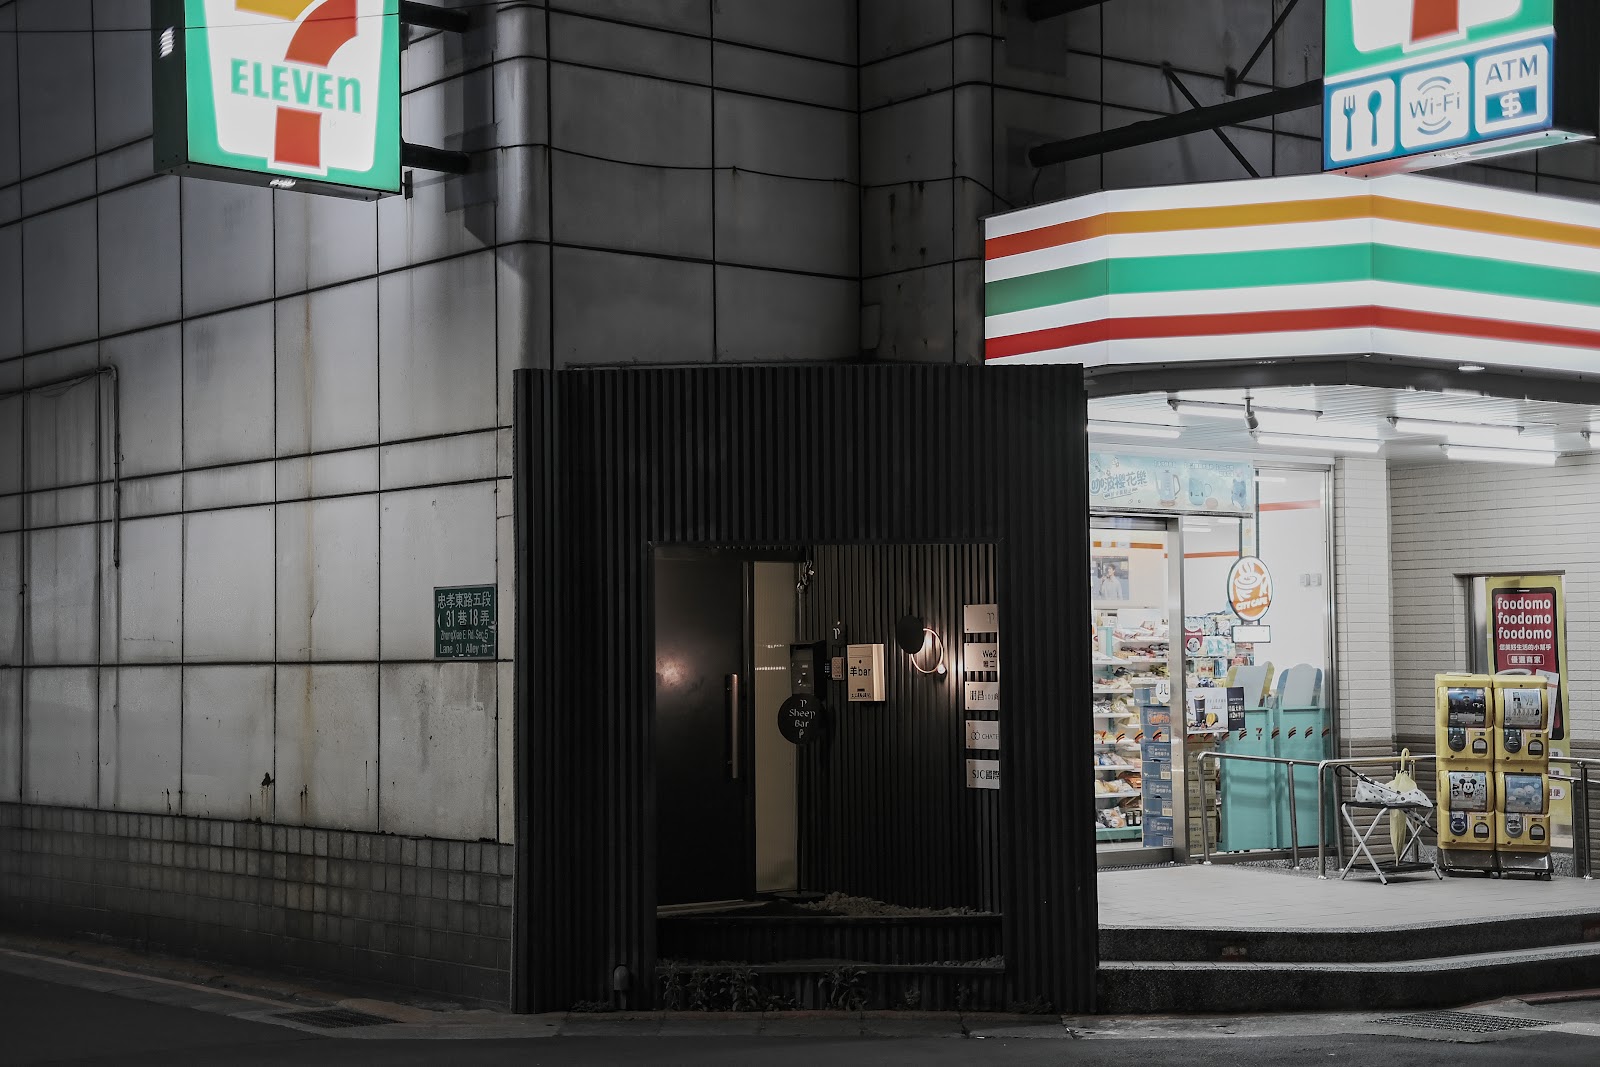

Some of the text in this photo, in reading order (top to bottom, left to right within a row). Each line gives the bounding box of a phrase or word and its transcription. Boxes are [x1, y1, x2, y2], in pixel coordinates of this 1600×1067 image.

[1485, 54, 1538, 85] ATM
[1409, 91, 1460, 118] Wi-Fi
[437, 591, 492, 609] 忠孝東路五段
[1235, 601, 1251, 611] CITY
[1497, 597, 1551, 609] foodomo
[1497, 612, 1552, 624] foodomo
[1498, 626, 1552, 639] foodomo
[440, 643, 453, 654] Lane
[455, 643, 463, 653] 31
[465, 643, 479, 655] Alley
[789, 708, 816, 720] Sheep
